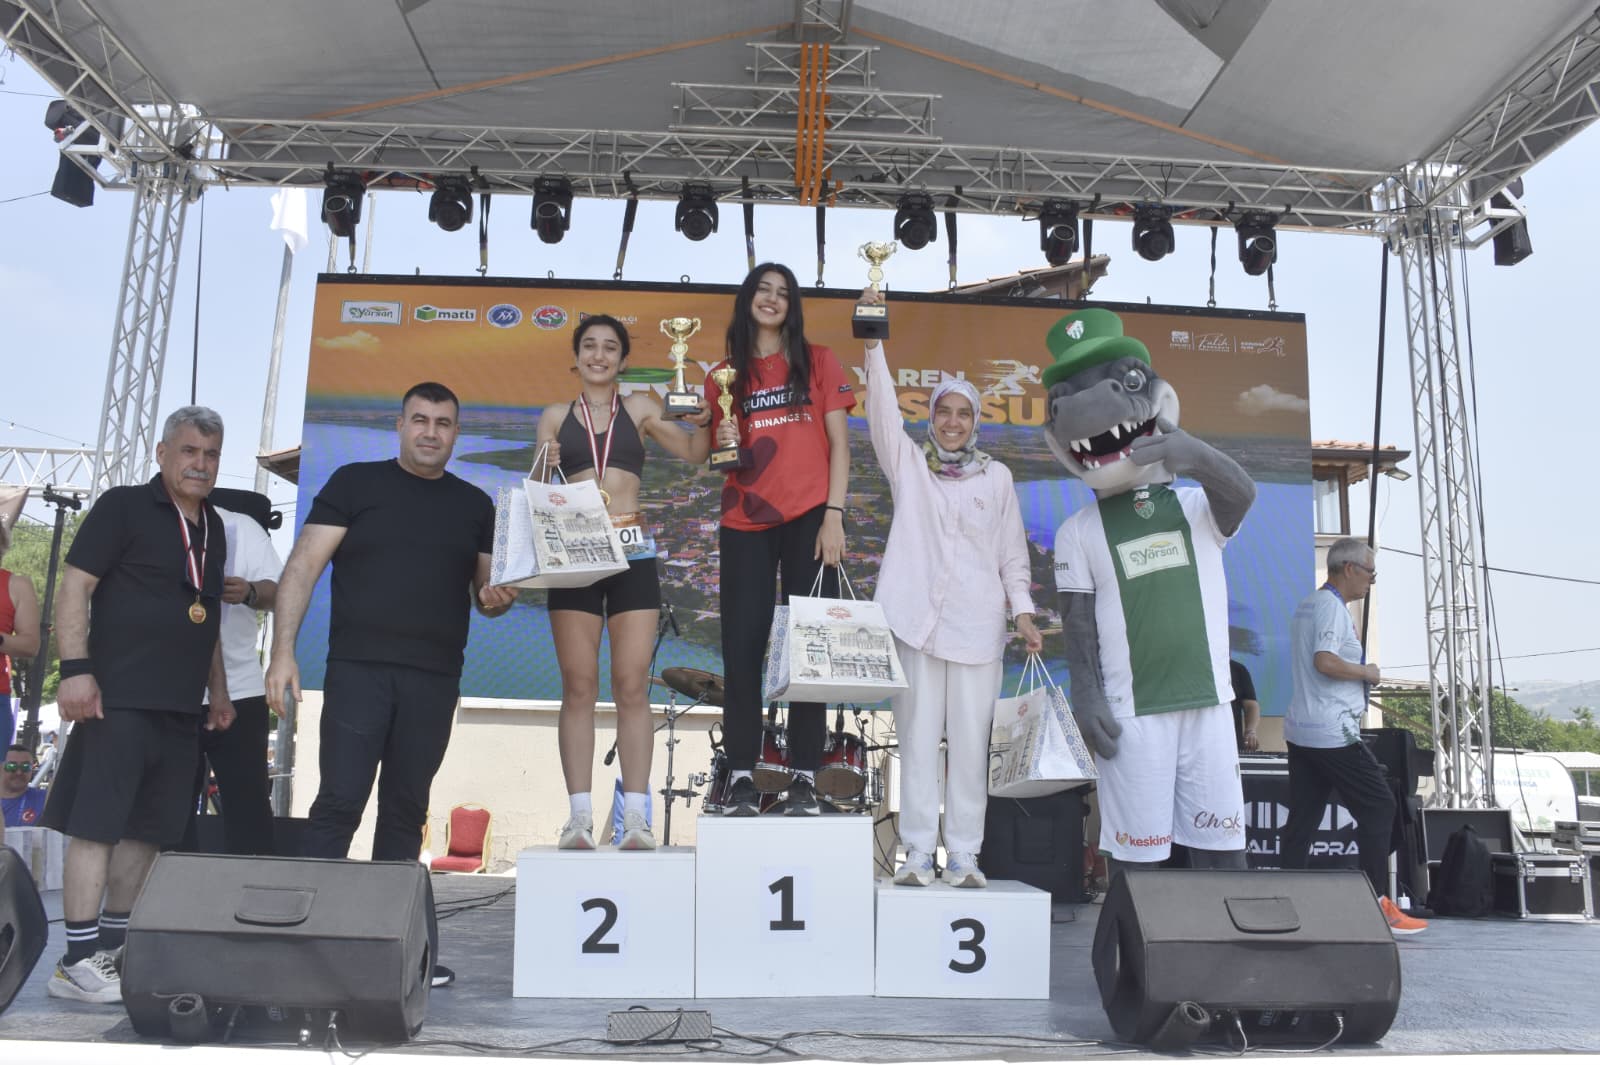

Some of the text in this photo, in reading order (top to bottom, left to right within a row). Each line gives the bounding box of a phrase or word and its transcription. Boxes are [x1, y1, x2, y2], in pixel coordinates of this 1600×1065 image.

[851, 366, 966, 388] YREN
[754, 412, 801, 429] BINANCE
[1134, 546, 1179, 565] Yörsan
[768, 875, 806, 931] 1
[581, 898, 620, 954] 2
[948, 918, 987, 974] 3
